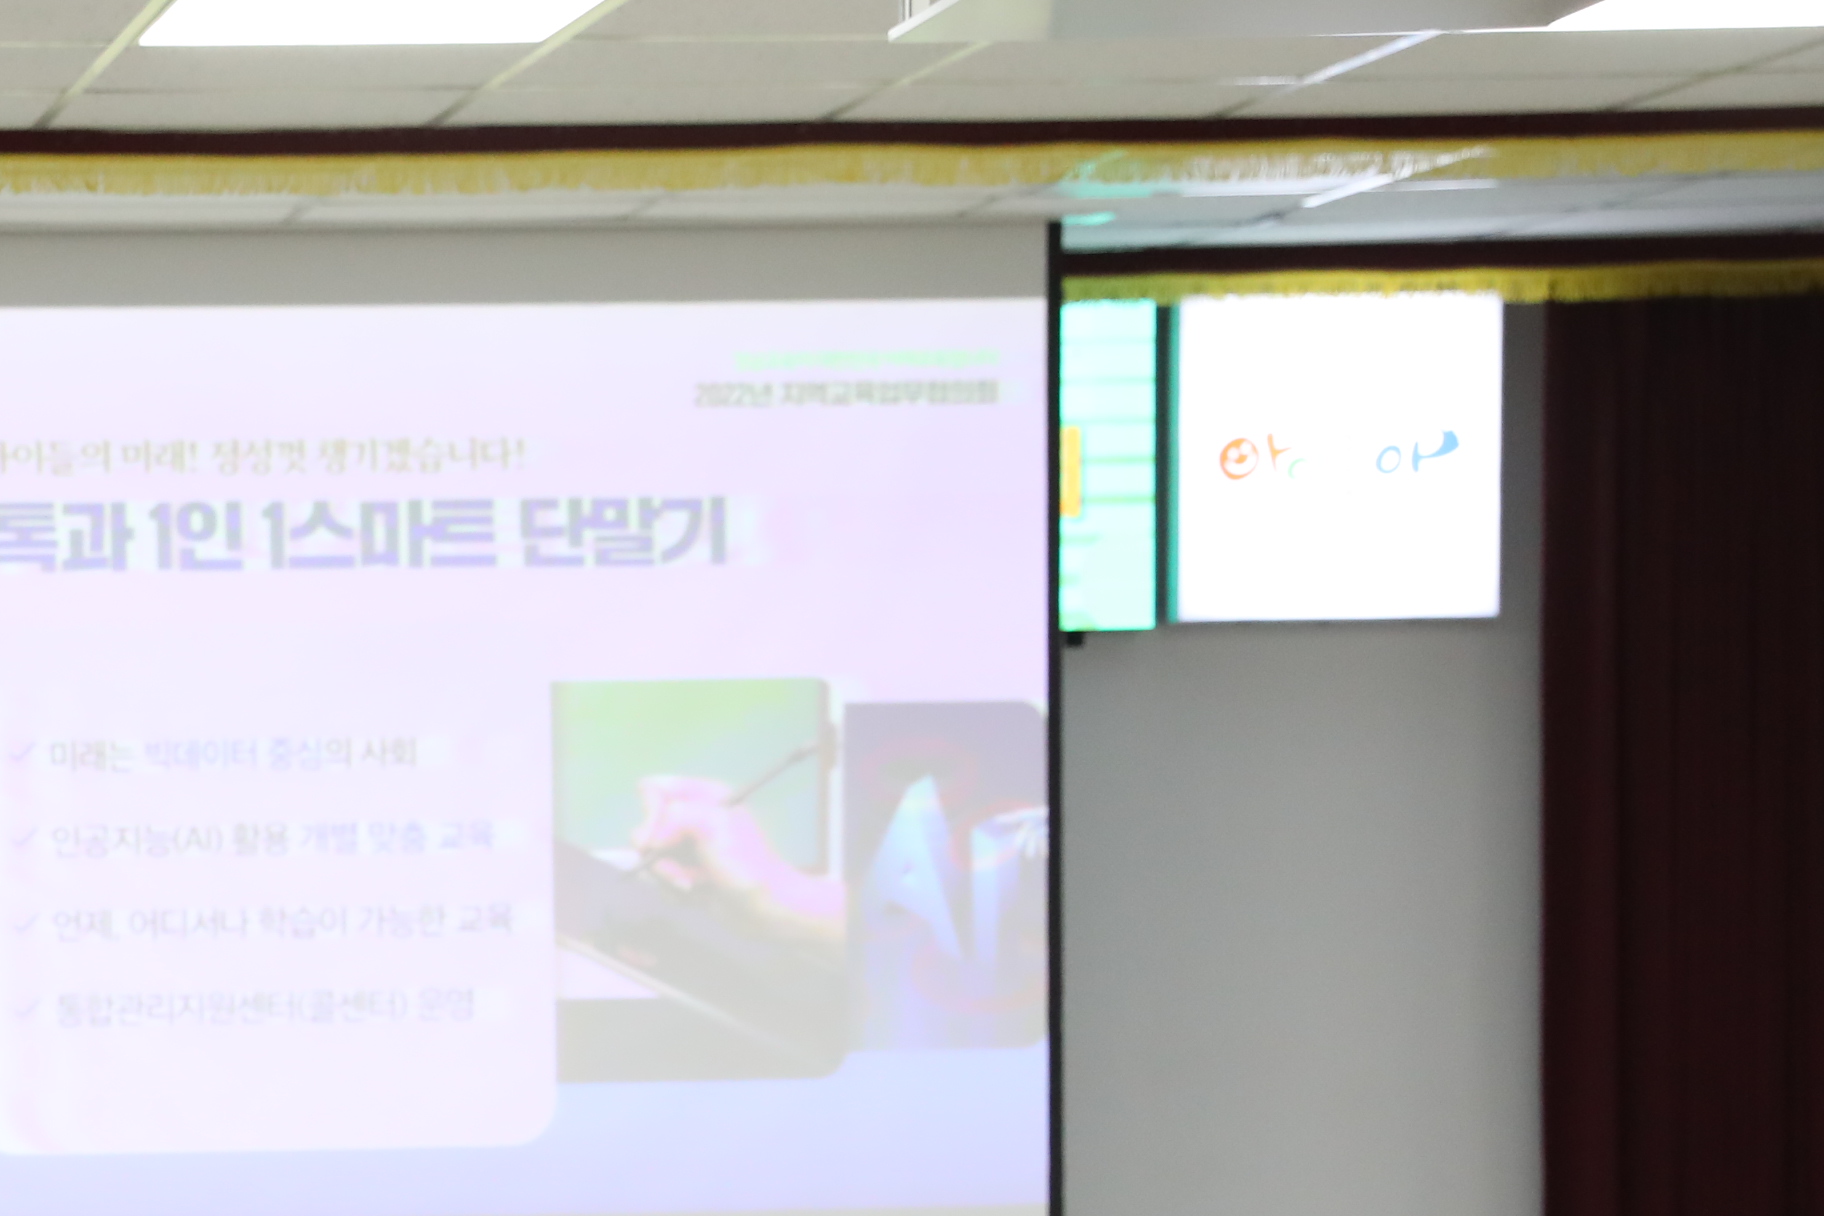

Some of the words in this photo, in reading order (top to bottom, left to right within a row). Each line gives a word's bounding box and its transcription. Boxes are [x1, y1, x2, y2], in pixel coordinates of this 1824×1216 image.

[118, 439, 197, 474] 미래!
[147, 501, 245, 571] 1인
[259, 498, 498, 570] 1스마트
[518, 496, 728, 566] 단말기
[49, 737, 133, 772] 미래는
[144, 737, 258, 770] 빅데이터
[268, 737, 354, 770] 중심의
[361, 737, 419, 768] 사회
[51, 823, 223, 860] 인공지능(AI)
[232, 822, 289, 857] 활용
[300, 822, 359, 854] 개별
[369, 821, 428, 854] 맞춤
[439, 820, 495, 851] 교육
[128, 904, 250, 941] 어디서나
[260, 903, 348, 939] 학습이
[356, 903, 446, 938] 가능한
[455, 902, 515, 935] 교육
[418, 988, 476, 1021] 운영
